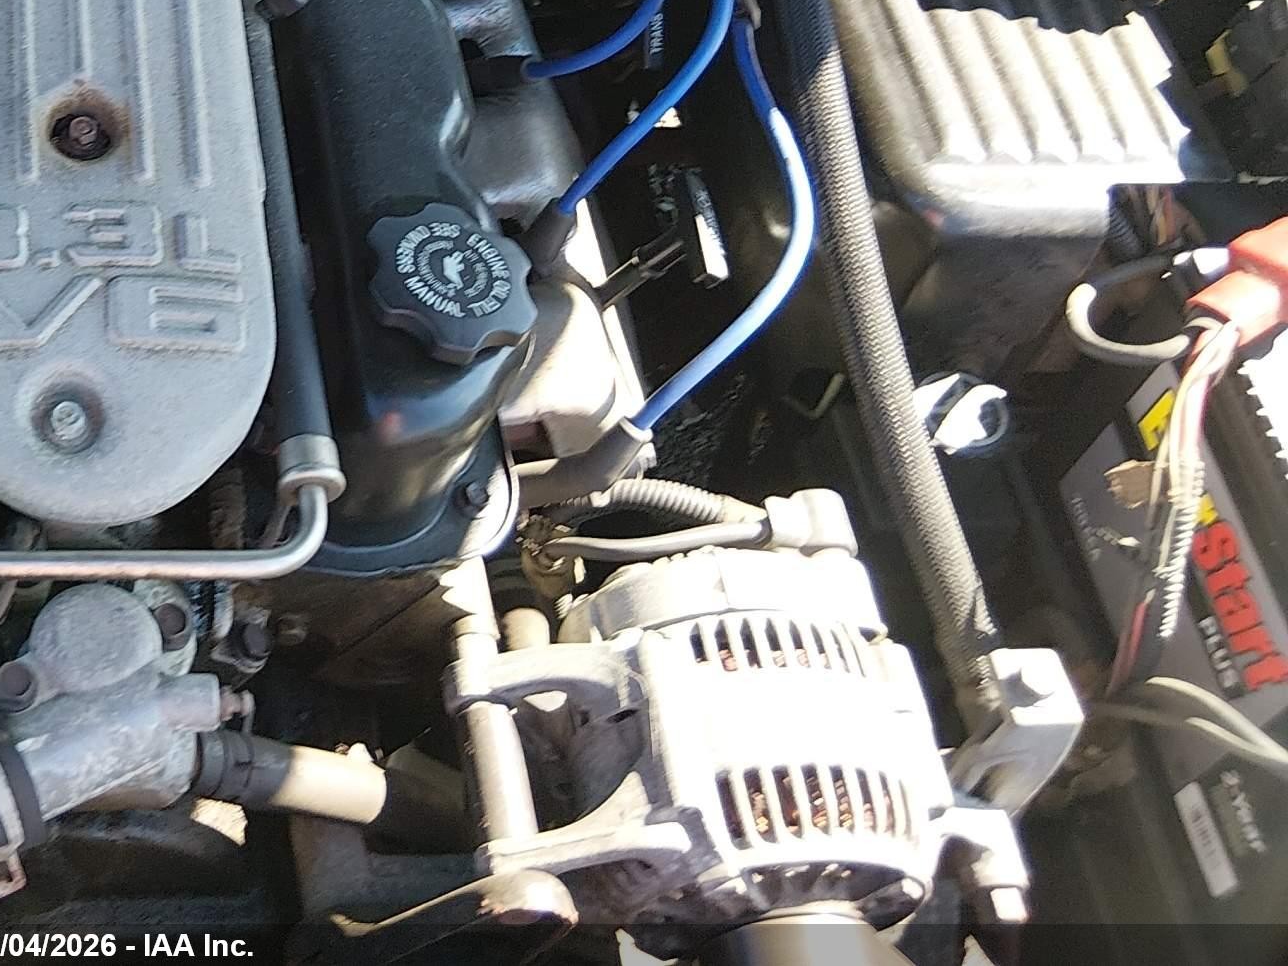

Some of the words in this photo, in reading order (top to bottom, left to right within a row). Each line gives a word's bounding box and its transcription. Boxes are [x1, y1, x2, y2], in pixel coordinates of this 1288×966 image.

[428, 222, 461, 239] SEE
[466, 234, 511, 280] ENGINE
[404, 276, 466, 318] MANUAL
[1200, 615, 1242, 690] PLUS
